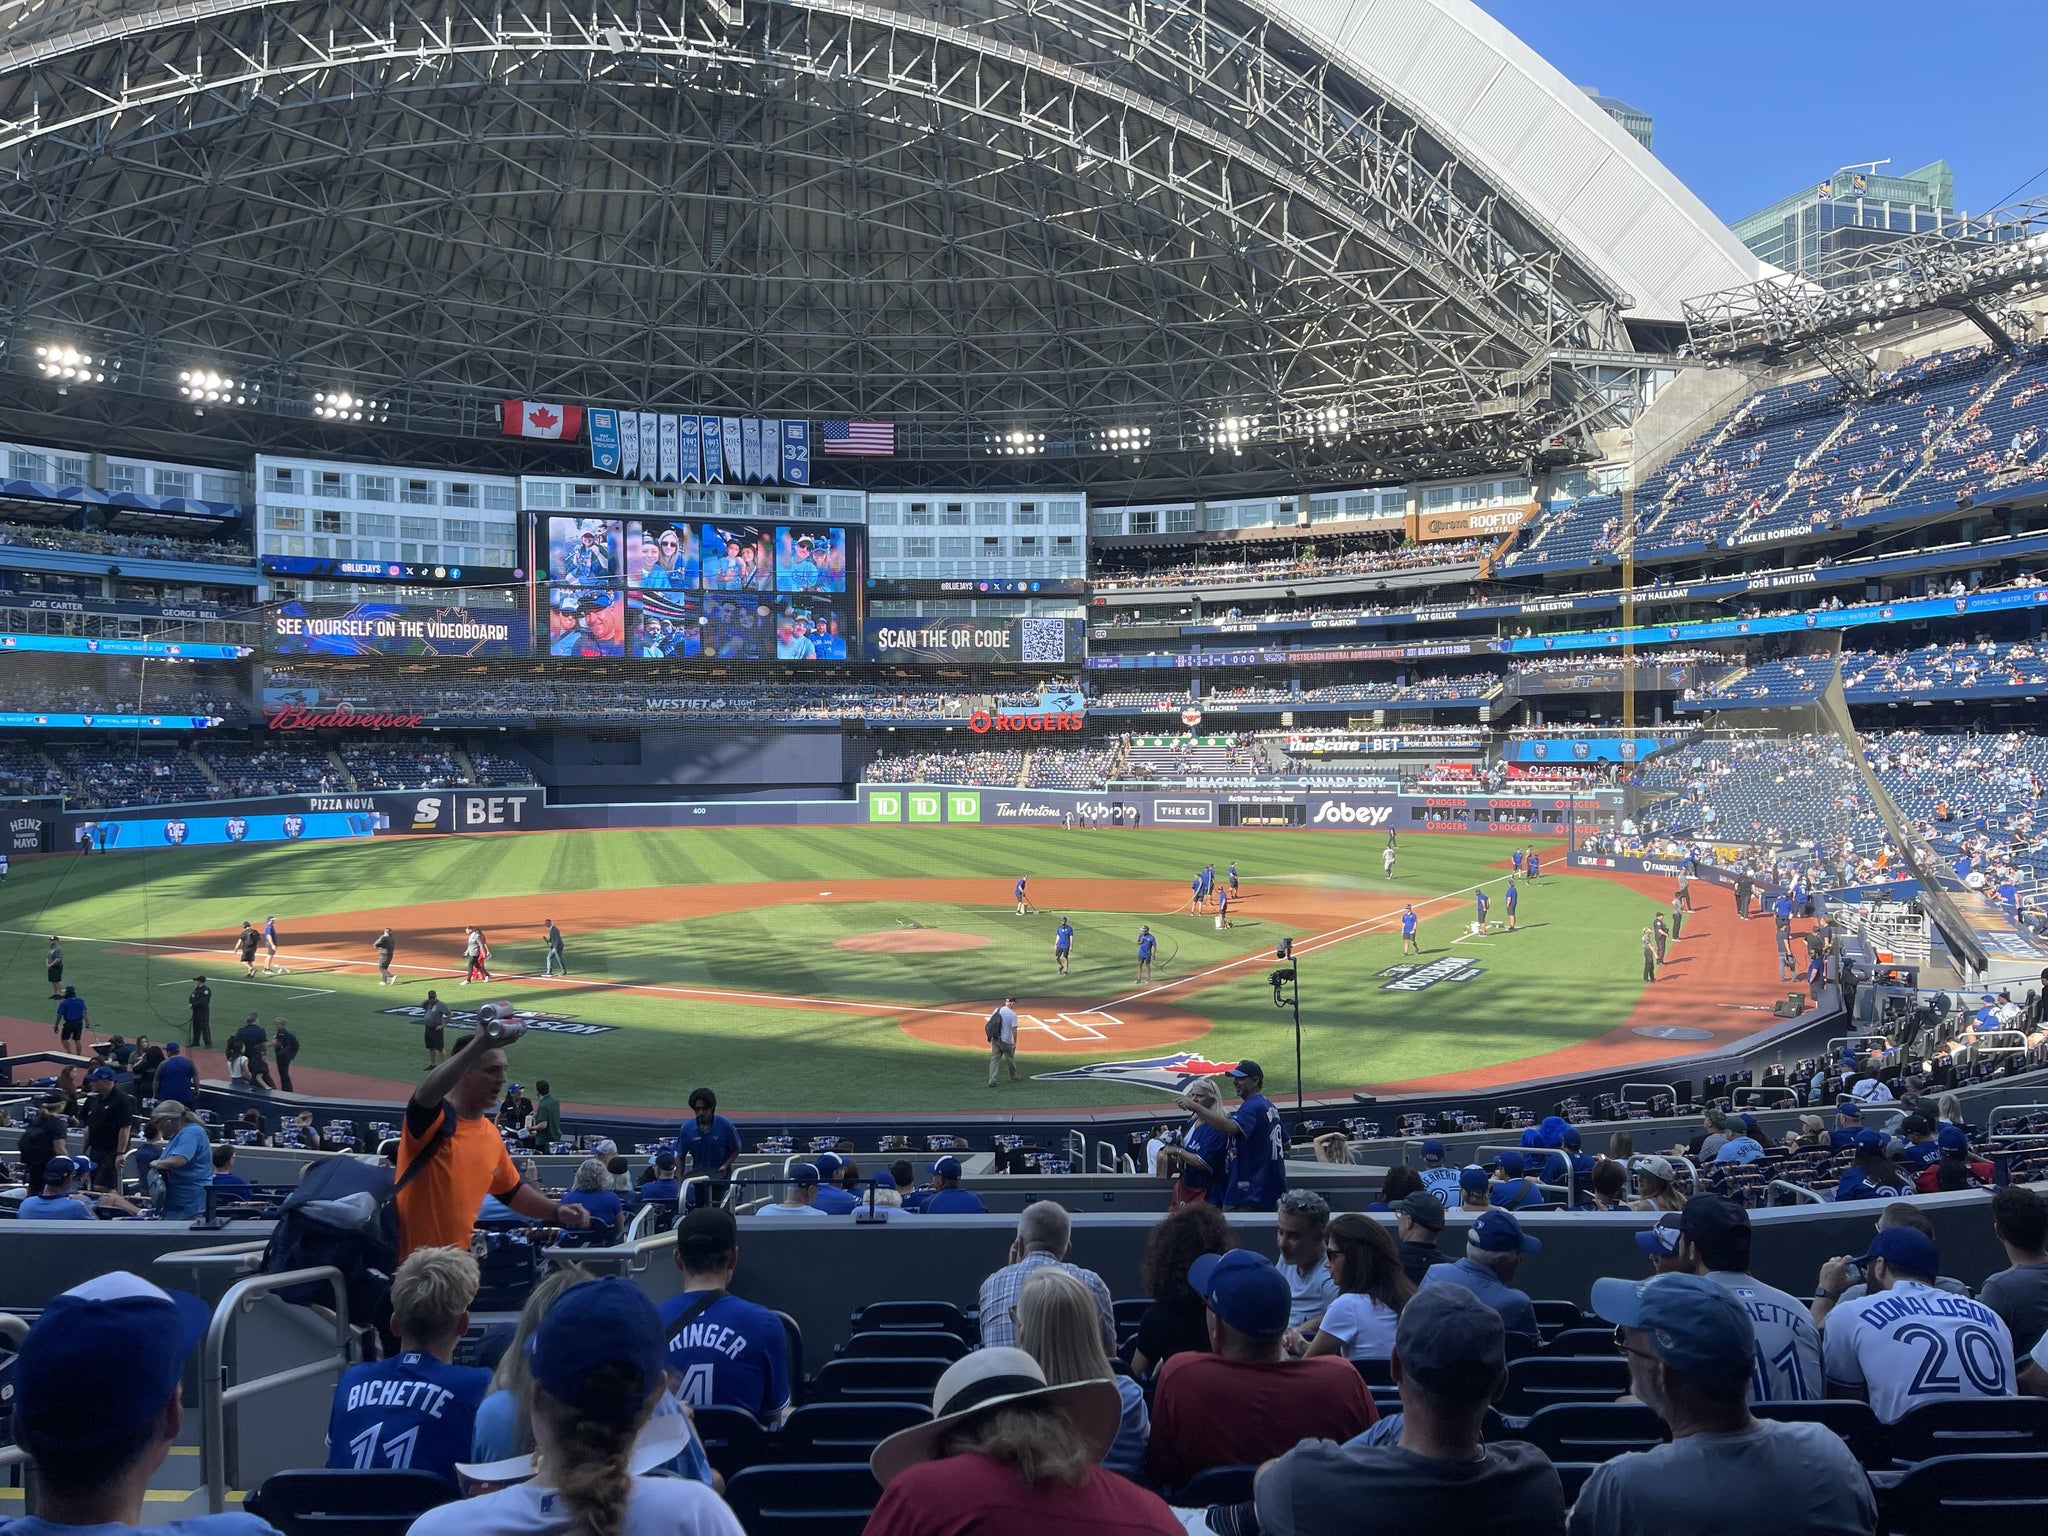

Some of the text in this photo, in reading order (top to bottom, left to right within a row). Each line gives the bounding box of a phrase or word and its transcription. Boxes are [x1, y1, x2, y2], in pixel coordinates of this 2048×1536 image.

[622, 433, 637, 443] 1985
[642, 437, 656, 447] 1989
[662, 438, 676, 447] 1991
[682, 437, 697, 448] 1992
[705, 439, 719, 448] 1993
[725, 438, 740, 447] 2015
[745, 439, 759, 448] 2016
[784, 444, 808, 462] 32
[1427, 512, 1524, 534] Corona ROOFTOP
[1738, 530, 1766, 545] JACKIE
[1767, 524, 1813, 542] ROBINSON
[341, 563, 381, 574] @BLUEJAYS
[940, 581, 974, 591] @BLUEJAYS
[1747, 572, 1817, 590] JOSÉ BAUTISTA
[1631, 592, 1647, 602] ROY
[1648, 588, 1689, 601] HALLADAY
[1972, 594, 2032, 607] OFFICIAL WATER OF
[29, 600, 83, 611] JOE CARTER
[1521, 600, 1573, 613] PAUL BEESTON
[162, 608, 218, 619] GEORGE BELL
[1416, 610, 1457, 622] PAT GILLICK
[1848, 612, 1868, 621] WATER
[1221, 624, 1237, 632] DAVE
[1311, 618, 1357, 628] CITO GASTON
[276, 618, 508, 641] SEE YOURSELF ON THE VIDEOBOARD!
[878, 628, 1011, 650] SCAN THE QR CODE
[1233, 655, 1238, 664] 0
[1241, 655, 1246, 663] 0
[1249, 654, 1255, 663] 0
[1288, 653, 1325, 663] POSTSEASON
[1325, 651, 1350, 661] GENERAL
[1350, 650, 1382, 660] ADMISSION
[1382, 649, 1405, 659] TICKETS
[1417, 646, 1445, 657] BLUEJAYS
[1169, 705, 1181, 713] DRY
[262, 703, 424, 731] Budweiser
[995, 713, 1083, 732] ROGERS
[1289, 737, 1361, 751] theScore
[1373, 738, 1400, 751] BET
[310, 797, 376, 811] PIZZA NOVA
[1228, 795, 1250, 803] Active
[1435, 798, 1467, 807] ROGERS
[1498, 799, 1532, 808] ROGERS
[413, 796, 527, 825] S BET
[692, 807, 707, 815] 400
[872, 797, 898, 816] TD
[911, 797, 938, 816] TD
[951, 797, 978, 816] TD
[996, 802, 1061, 817] Tim Hortons
[1076, 801, 1138, 818] Kubota
[1161, 806, 1206, 816] THE KEG
[1313, 800, 1393, 826] Sobeys
[10, 817, 42, 832] HEINZ
[167, 822, 186, 831] Pure
[228, 818, 246, 828] Pure
[285, 817, 303, 826] Pure
[1435, 822, 1467, 831] ROGERS
[230, 826, 245, 835] Life
[287, 824, 301, 833] Life
[1498, 823, 1532, 832] ROGERS
[169, 829, 184, 839] Life
[13, 837, 39, 849] MAYO
[1651, 863, 1680, 872] FANDUEL
[1970, 875, 1980, 883] 27
[1859, 1295, 2000, 1332] DONALDSON
[1892, 1322, 2008, 1397] 20
[673, 1362, 714, 1406] 4
[346, 1379, 455, 1419] BICHETTE
[349, 1421, 420, 1470] 11
